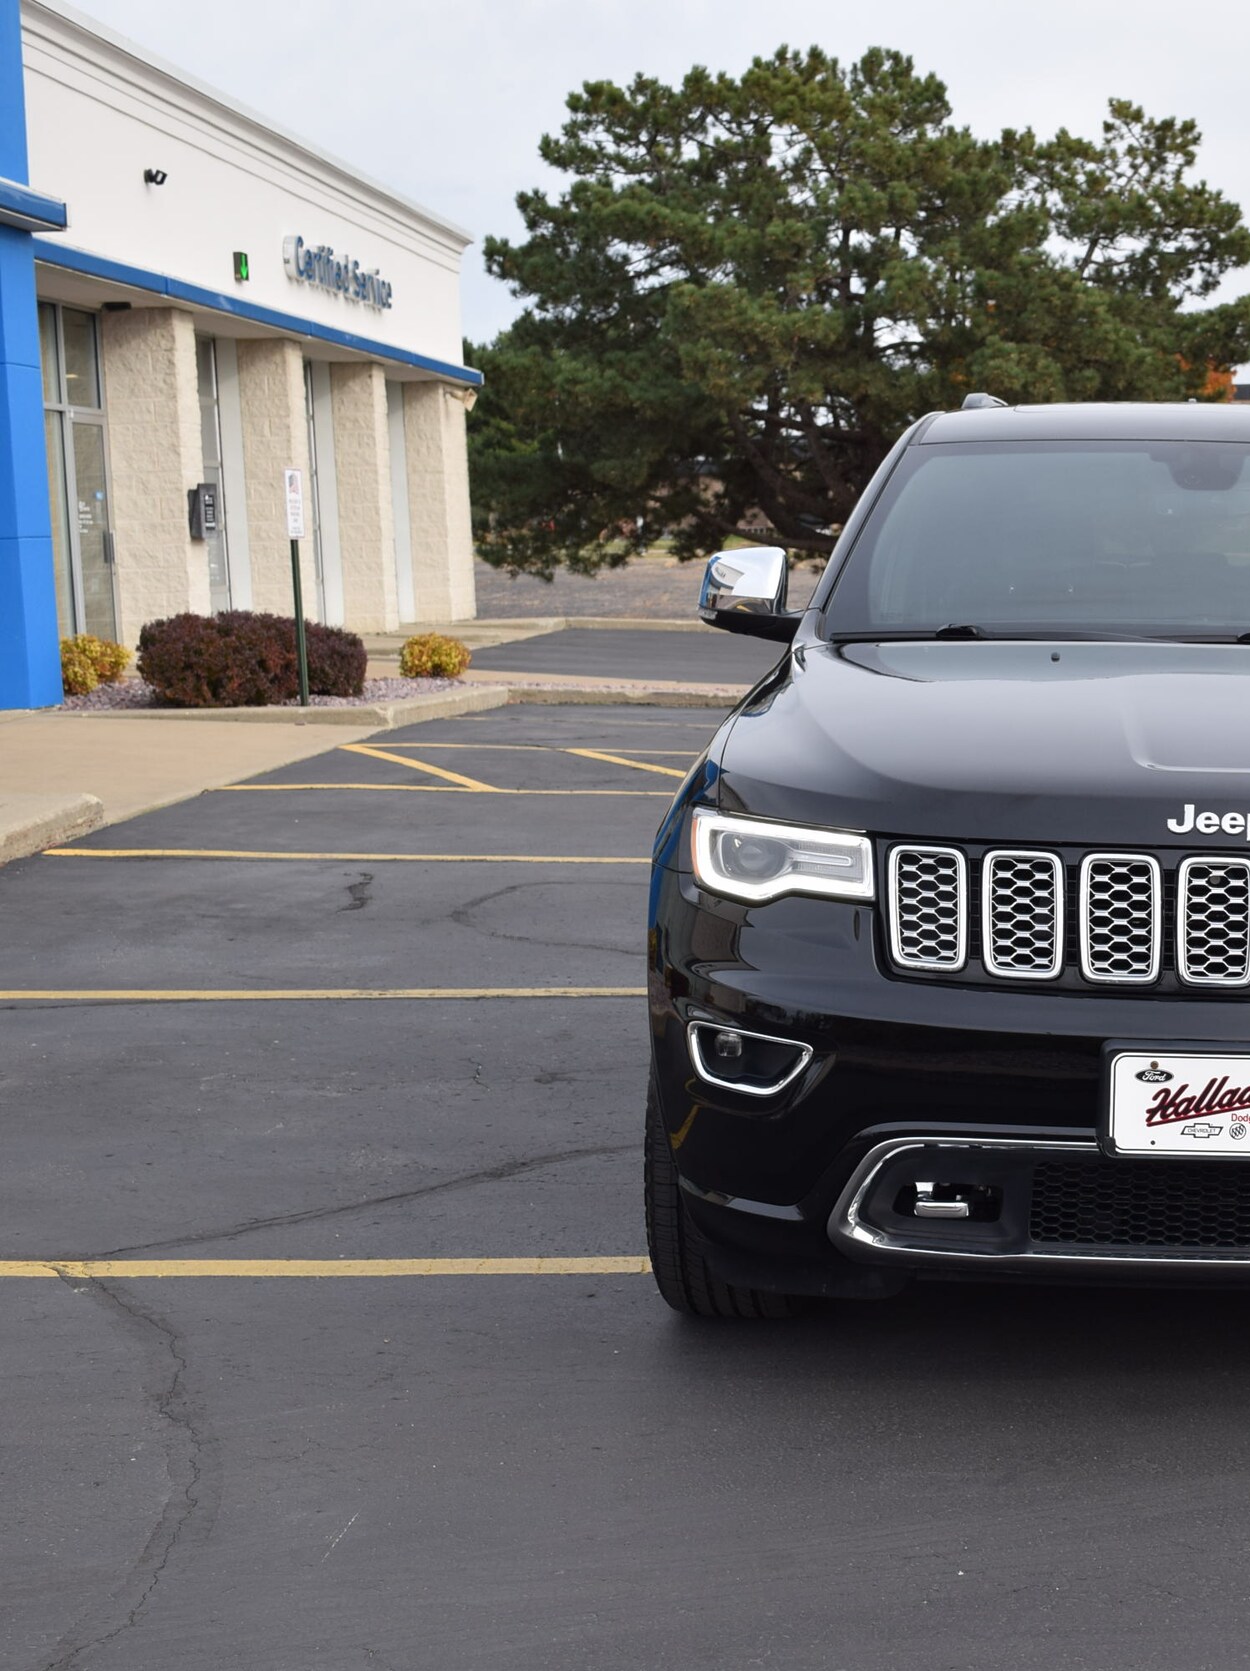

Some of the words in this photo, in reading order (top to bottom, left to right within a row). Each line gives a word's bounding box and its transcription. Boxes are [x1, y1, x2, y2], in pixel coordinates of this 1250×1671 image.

[293, 235, 349, 293] Certified
[351, 259, 393, 309] Service
[1141, 1069, 1167, 1082] Ford
